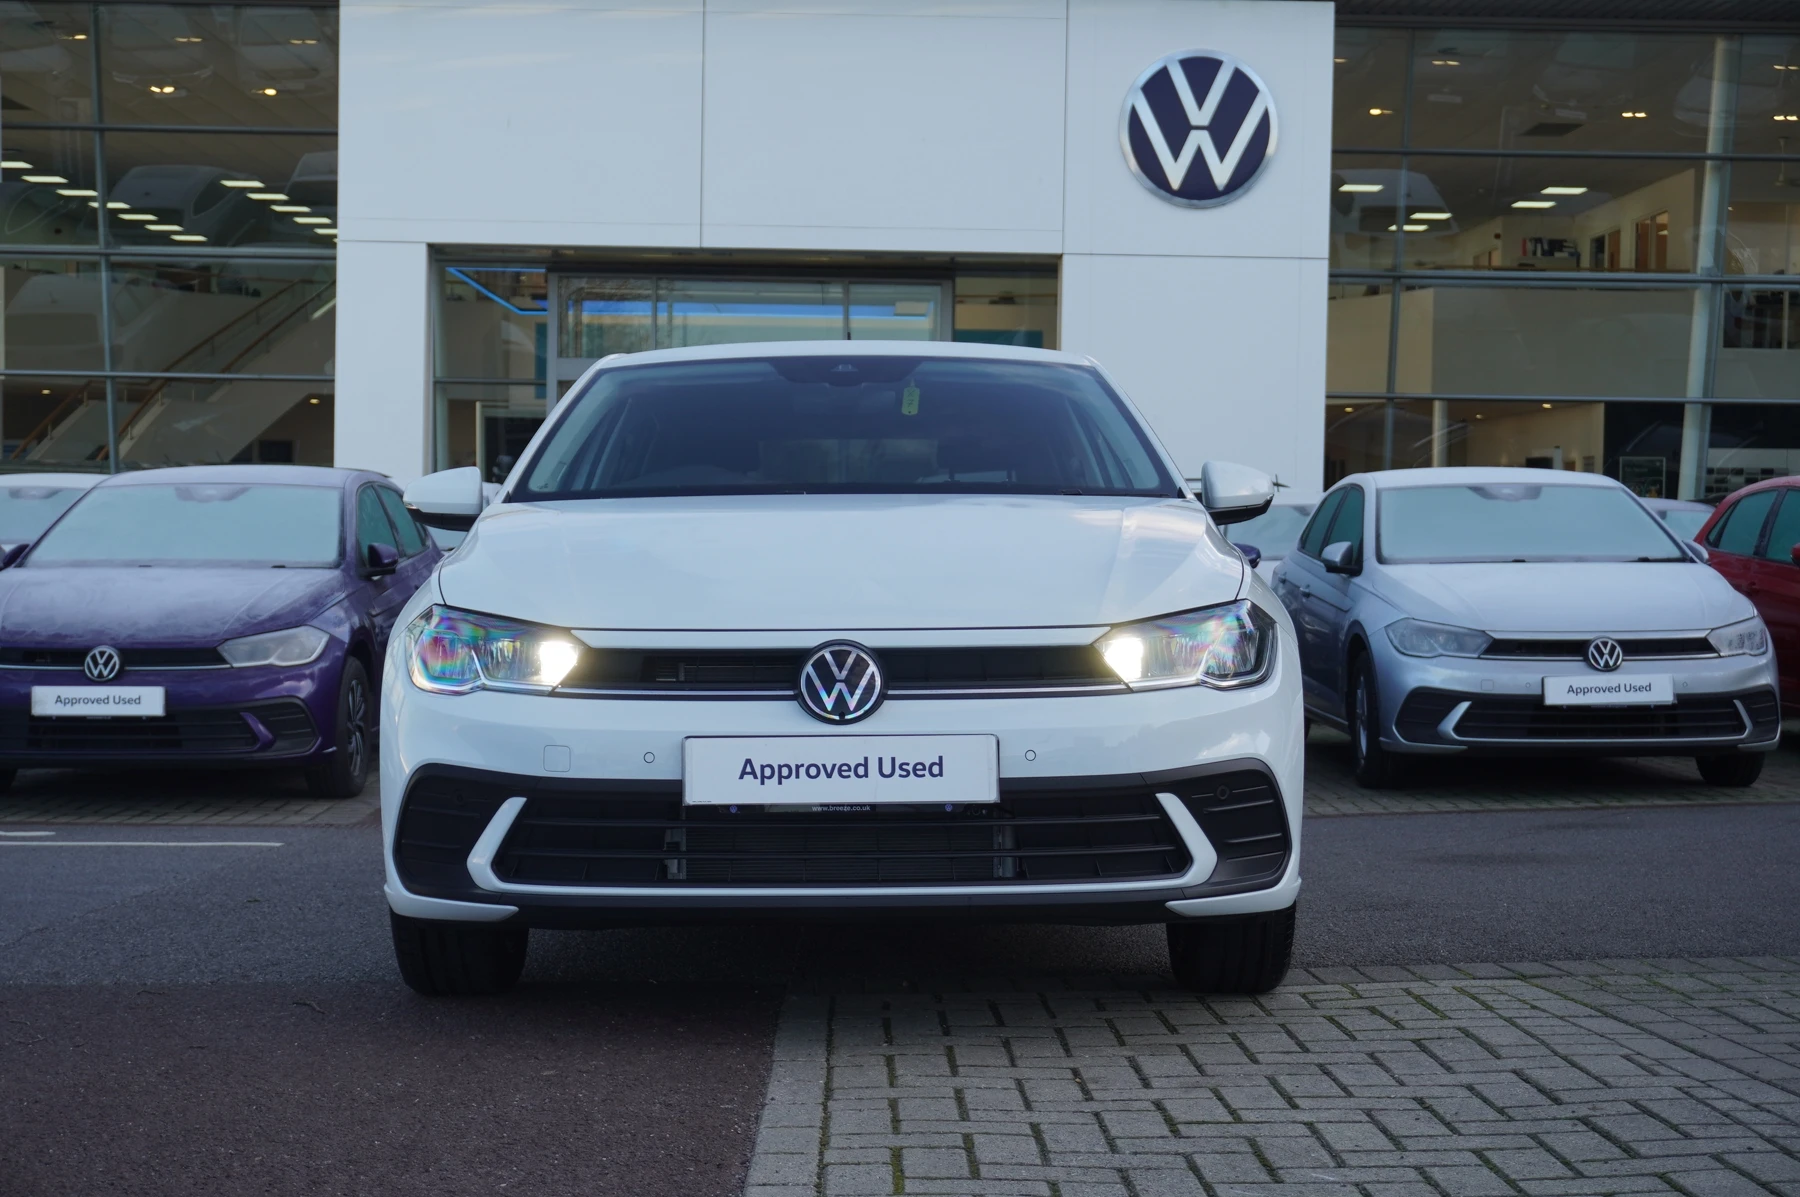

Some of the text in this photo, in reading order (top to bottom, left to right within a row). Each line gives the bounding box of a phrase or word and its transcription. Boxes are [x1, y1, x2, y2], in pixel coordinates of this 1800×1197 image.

[1130, 55, 1269, 192] VW
[86, 649, 118, 678] VW
[1590, 640, 1621, 668] VW
[804, 649, 877, 714] VW
[1566, 682, 1652, 697] Approved Used
[54, 695, 142, 707] Approved Used
[738, 755, 944, 785] Approved Used
